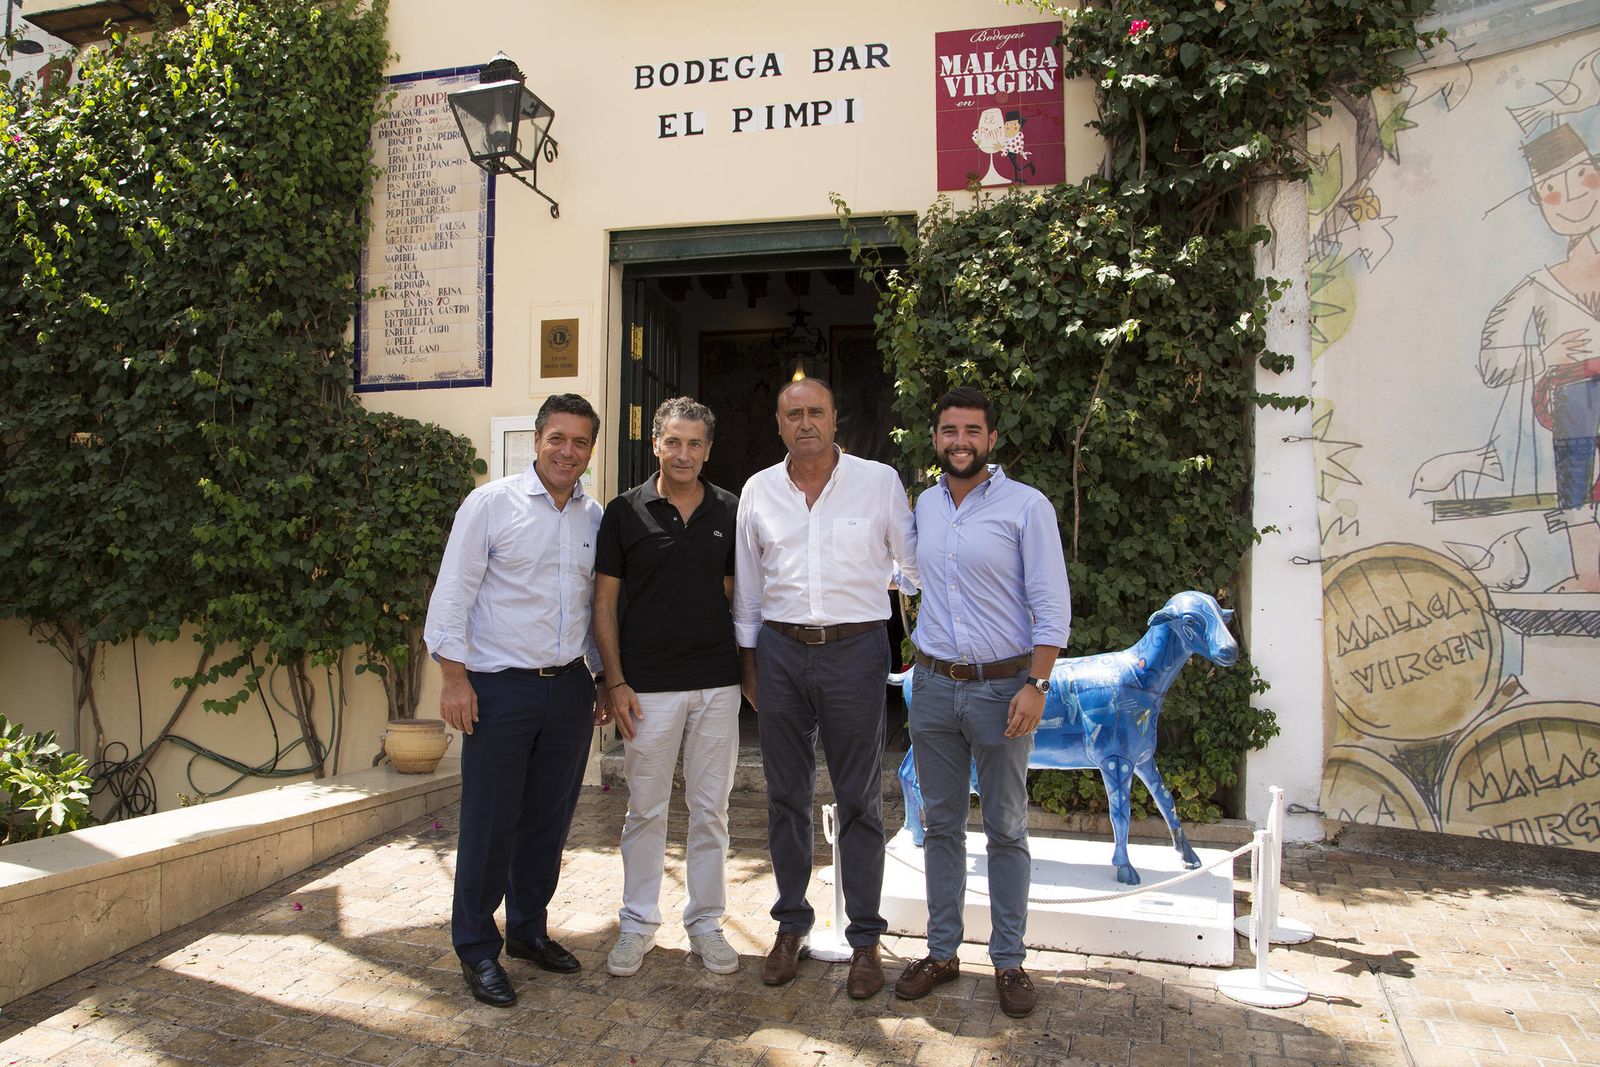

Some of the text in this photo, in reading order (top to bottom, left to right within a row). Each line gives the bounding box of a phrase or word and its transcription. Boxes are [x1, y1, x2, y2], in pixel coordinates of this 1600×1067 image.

[970, 29, 1026, 49] Bodegas
[634, 42, 890, 90] BODEGA BAR
[939, 46, 1059, 77] MALAGA
[944, 68, 1056, 98] VIRGEN
[379, 118, 420, 130] ACTUARON
[658, 97, 855, 139] EL PIMPI
[378, 127, 414, 140] PIONERO
[416, 143, 443, 152] PALMA
[388, 152, 433, 165] IRMA VILA
[388, 163, 408, 174] TRIO
[412, 161, 428, 171] LOS
[387, 170, 432, 182] FOSFORITO
[406, 179, 438, 189] VARGAS
[386, 204, 451, 218] PEPITO VARGAS
[385, 234, 415, 245] MIGUEL
[434, 230, 461, 242] REYES
[384, 252, 417, 263] MARIBEL
[394, 280, 431, 290] REPOMPA
[384, 290, 421, 300] ENCARNA
[438, 287, 463, 296] REINA
[384, 304, 470, 319] ESTRELLITA CASTRO
[384, 317, 435, 328] VICTORILLA
[384, 327, 418, 338] ENRIQUE
[394, 336, 415, 346] PELE
[384, 345, 416, 356] MANUEL
[1336, 587, 1471, 657] MALAGA
[1350, 629, 1486, 693] VIRGEN
